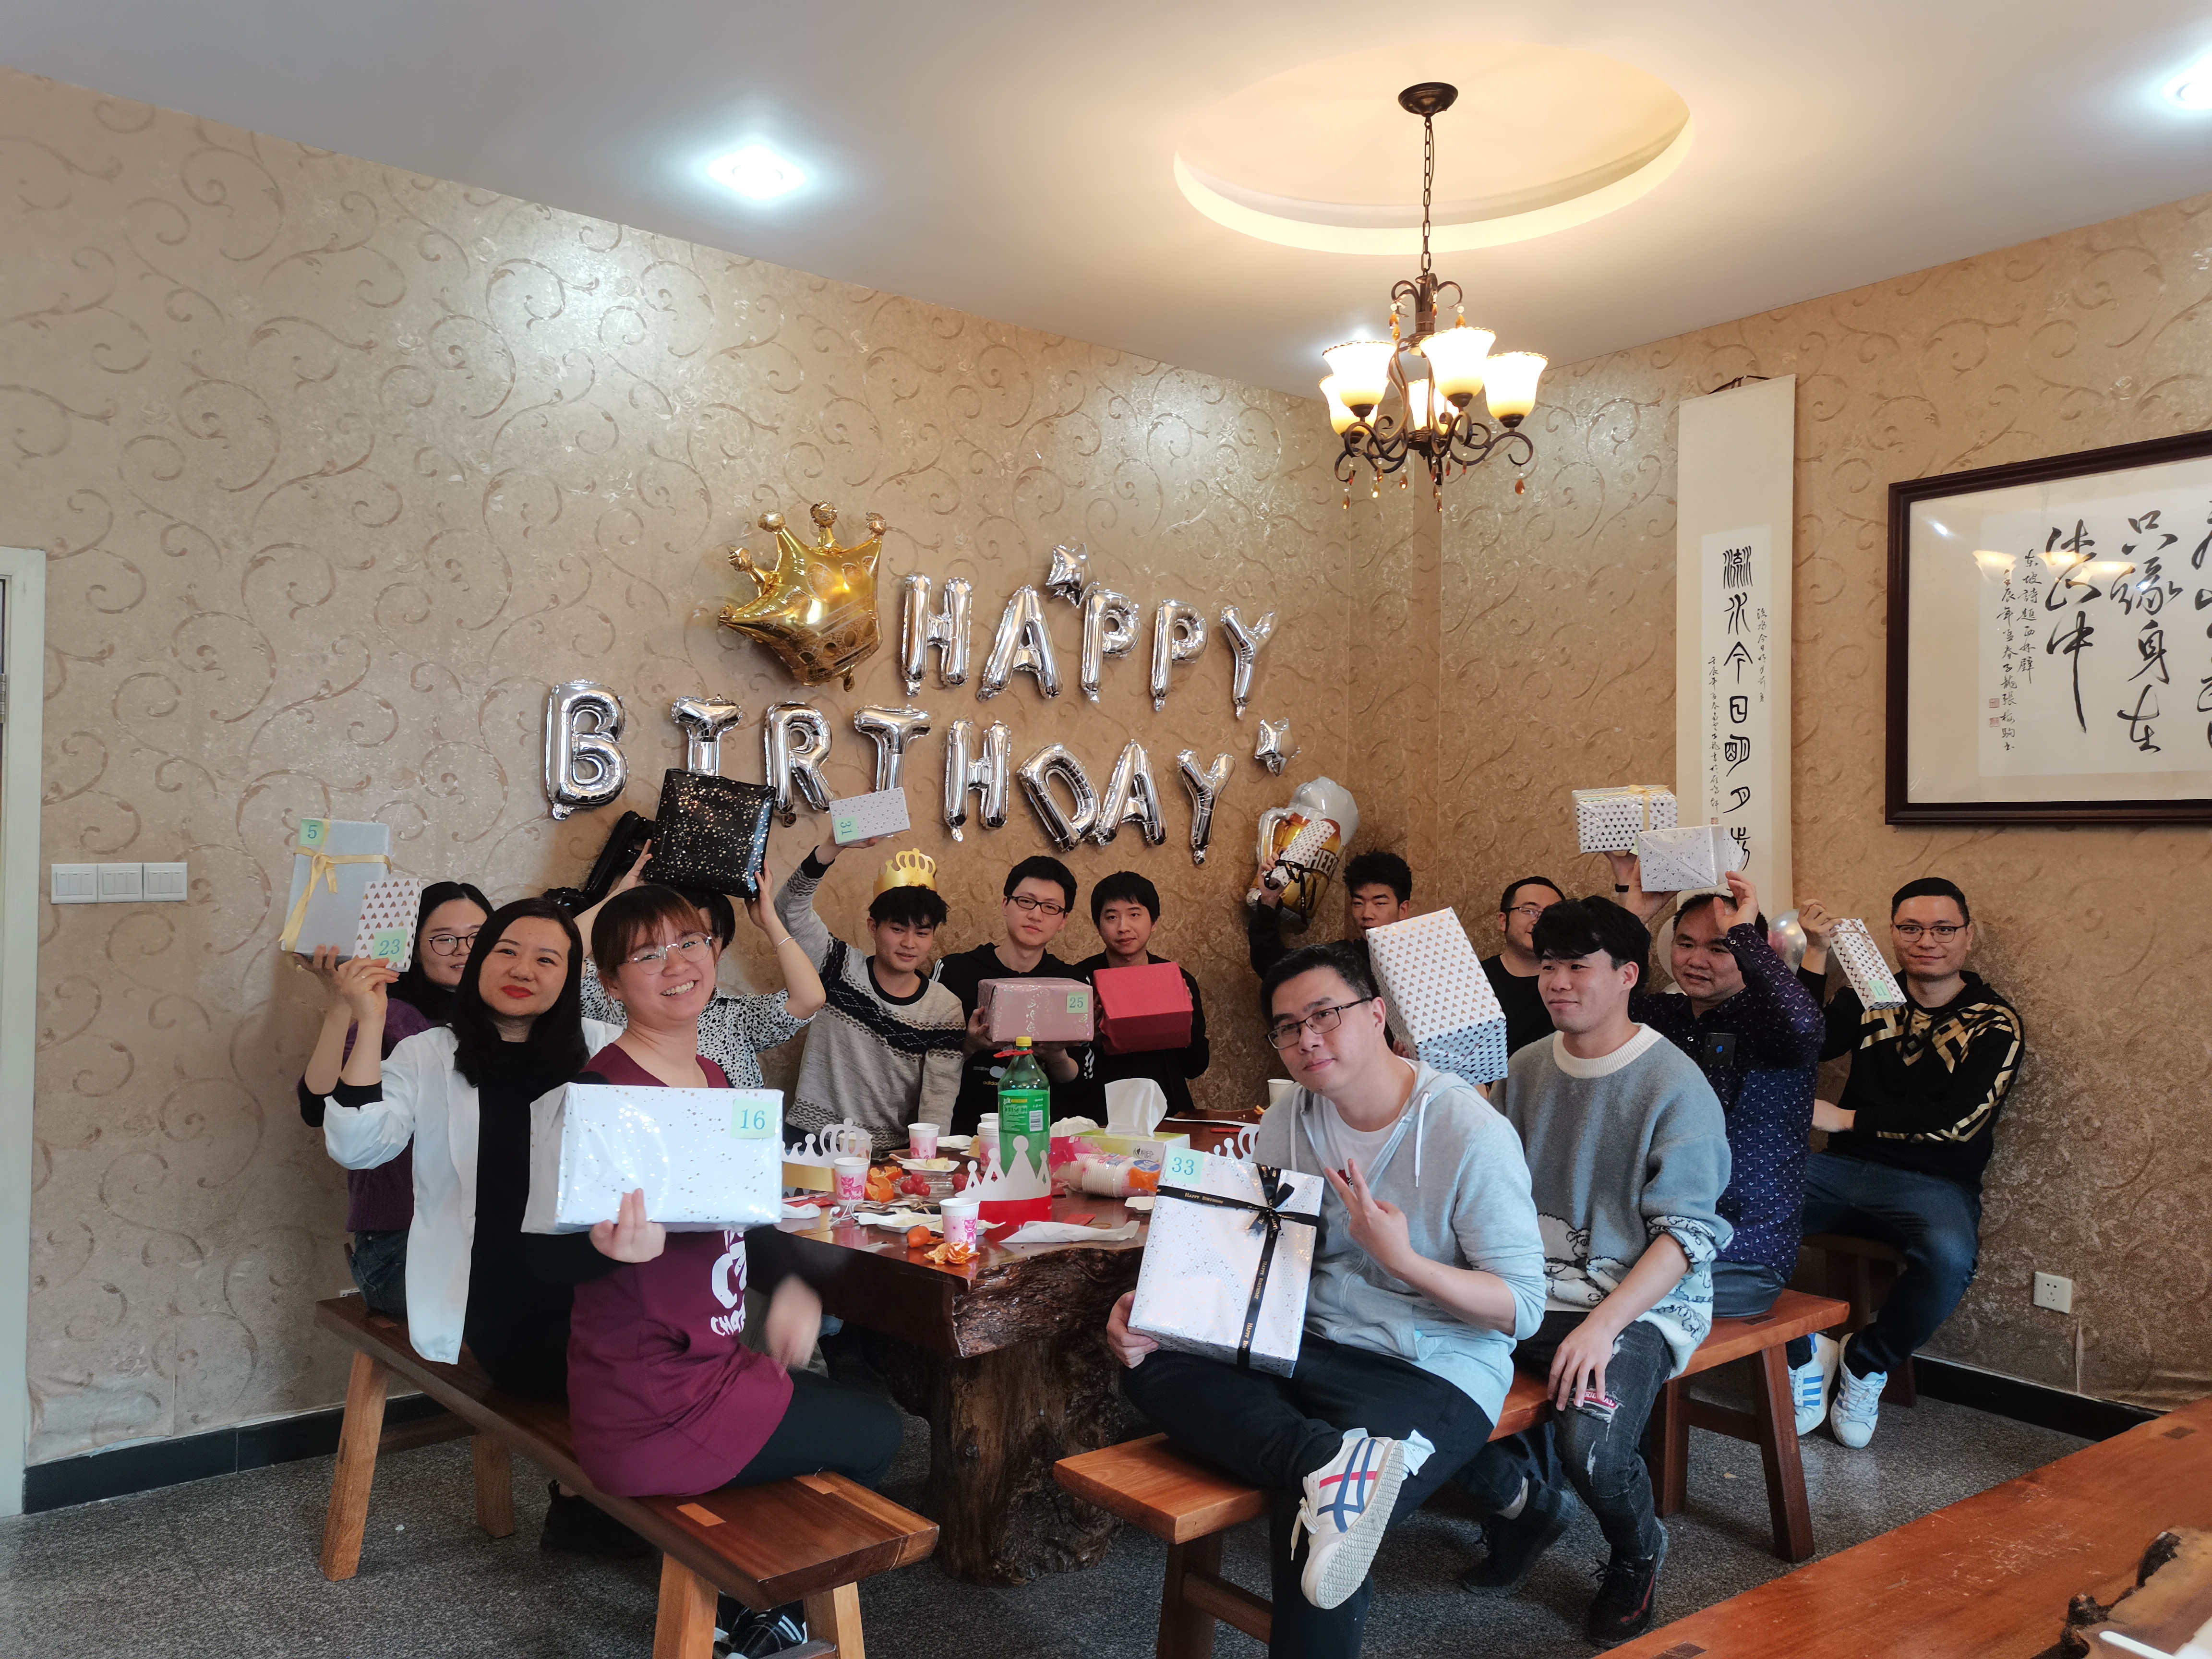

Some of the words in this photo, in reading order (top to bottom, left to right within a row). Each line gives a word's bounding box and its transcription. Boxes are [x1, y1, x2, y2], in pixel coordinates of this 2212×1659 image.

[901, 572, 1279, 720] HAPPY
[545, 679, 1236, 866] BIRTHDAY
[307, 824, 317, 839] 5
[840, 821, 853, 836] 31
[379, 938, 401, 956] 23
[1874, 986, 1887, 996] 11
[1069, 997, 1084, 1008] 25
[740, 1108, 766, 1130] 16
[1171, 1156, 1195, 1176] 33
